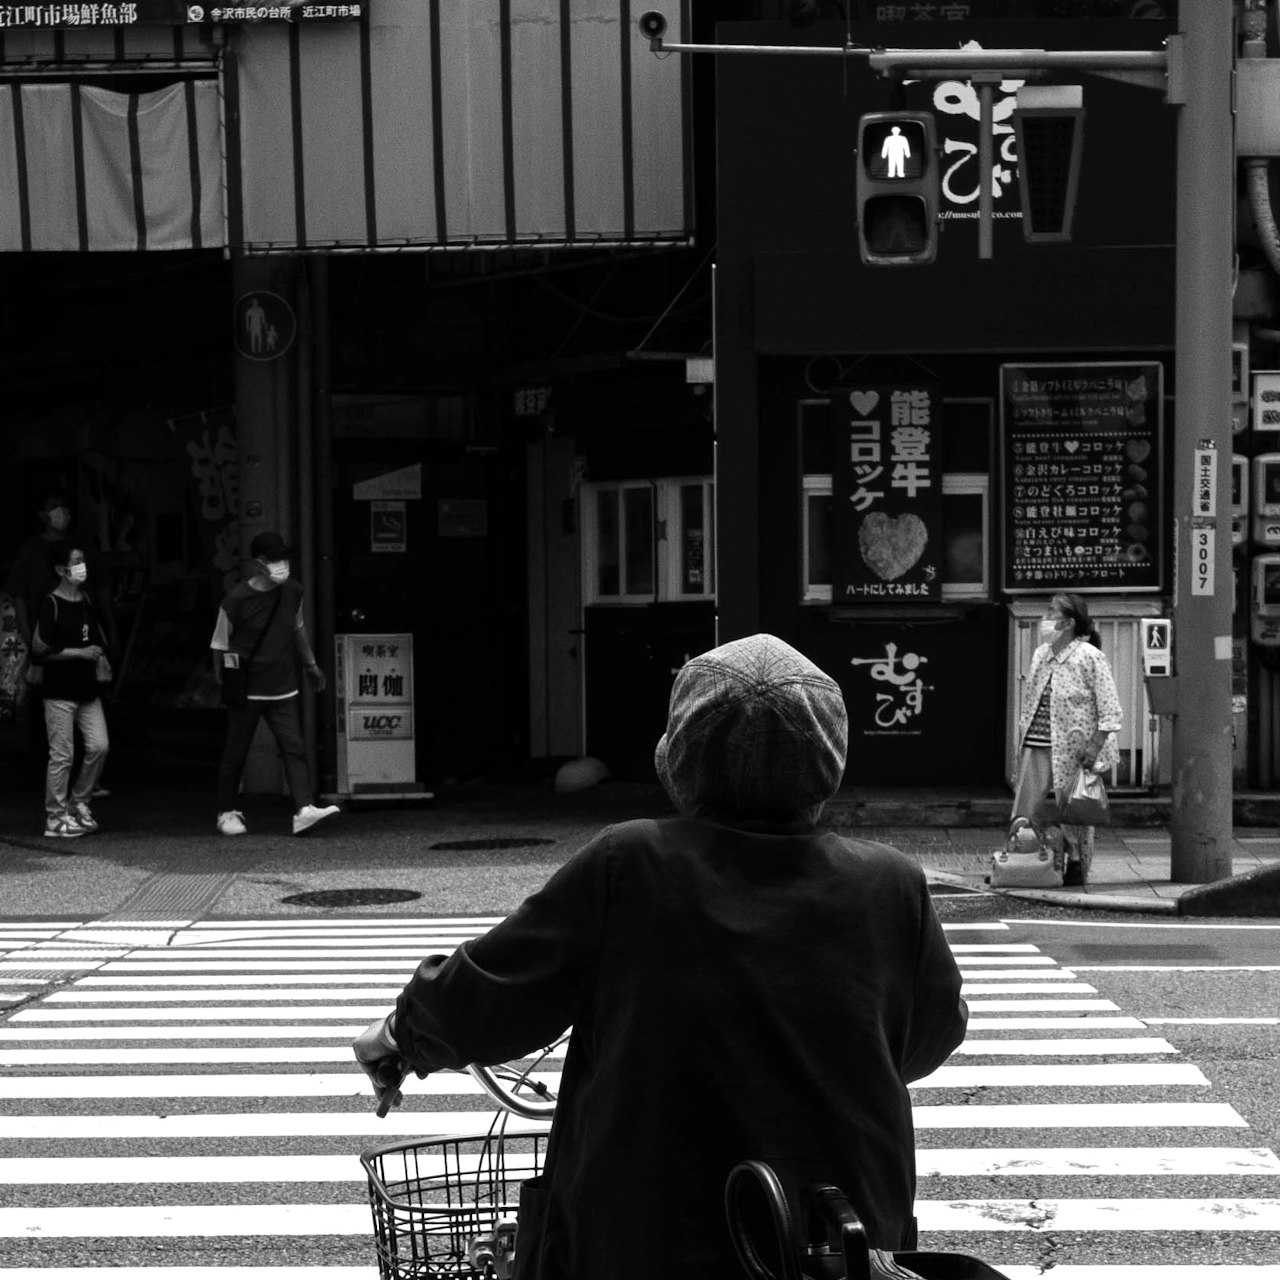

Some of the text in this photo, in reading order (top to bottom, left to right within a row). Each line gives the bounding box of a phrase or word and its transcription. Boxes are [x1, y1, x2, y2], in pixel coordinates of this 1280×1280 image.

[303, 4, 361, 18] 近江町市場
[889, 390, 932, 498] 能登牛
[1200, 455, 1212, 512] 国土交通省
[845, 582, 930, 597] ハートにしてみました
[1199, 533, 1208, 590] 3007
[363, 645, 398, 657] 喫茶室
[850, 641, 935, 728] むすび
